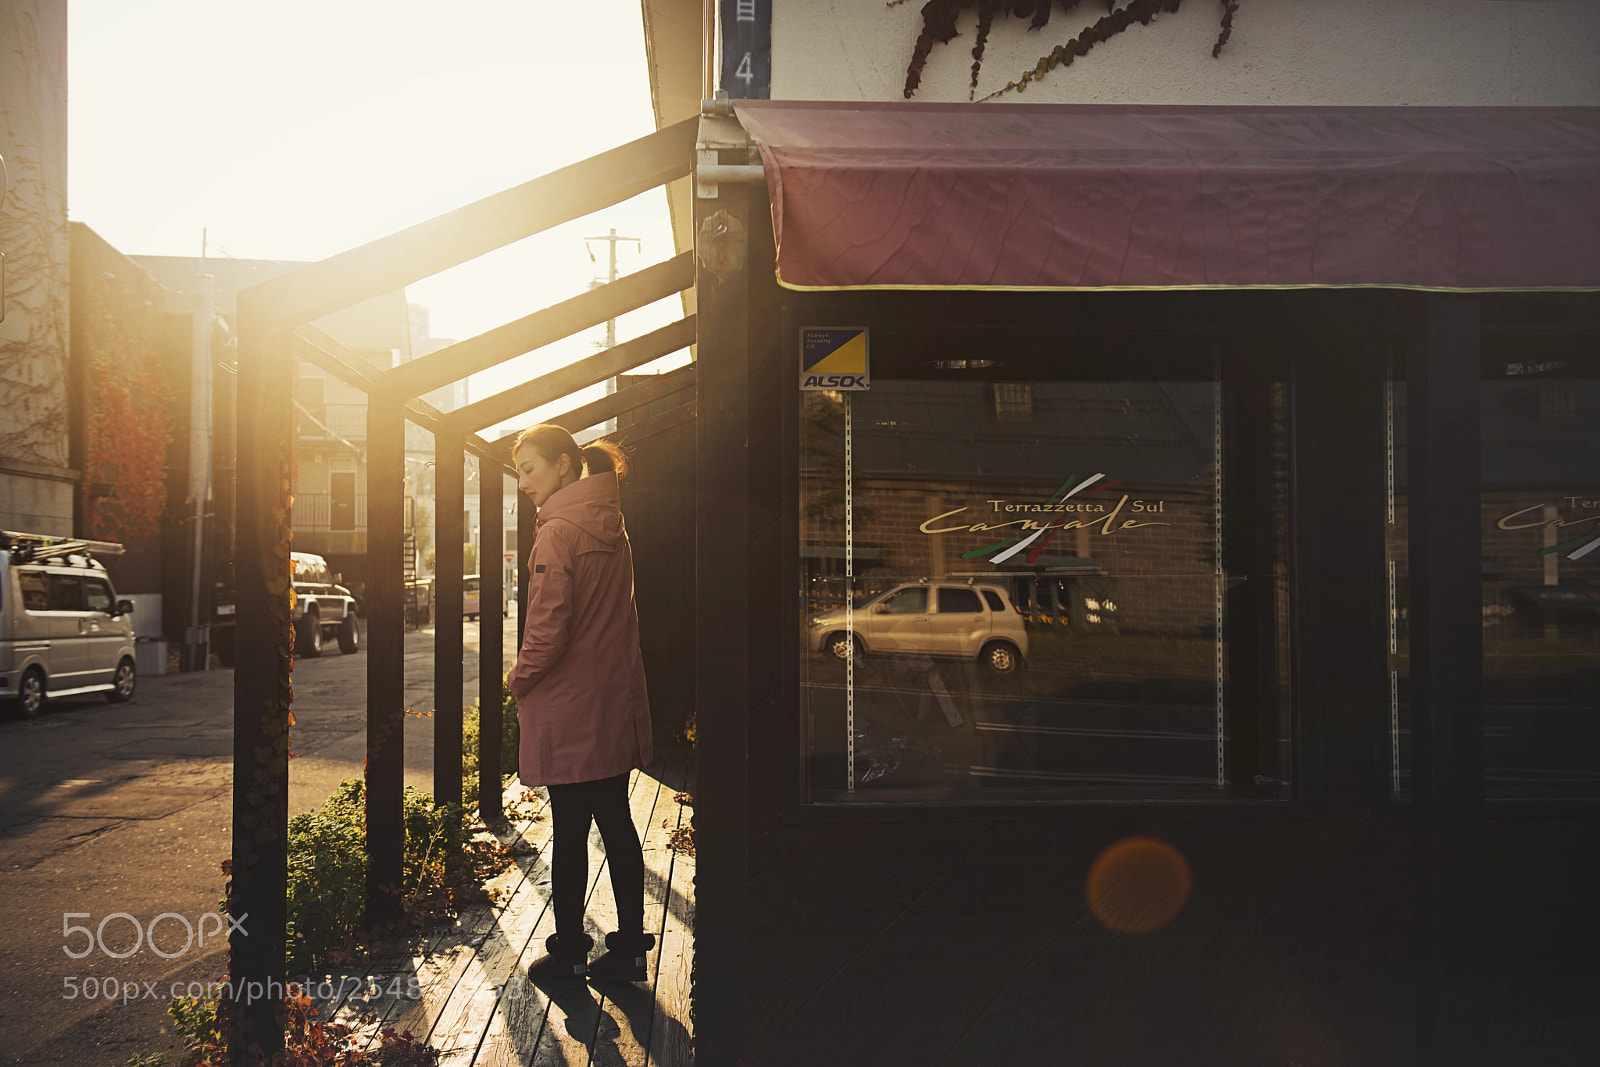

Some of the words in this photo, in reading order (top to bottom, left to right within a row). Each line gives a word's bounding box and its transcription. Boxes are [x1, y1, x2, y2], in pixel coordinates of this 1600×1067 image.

[735, 52, 753, 85] 4
[803, 375, 866, 388] ALSOK
[987, 499, 1105, 513] Terrazzetta
[1131, 500, 1165, 513] Sul
